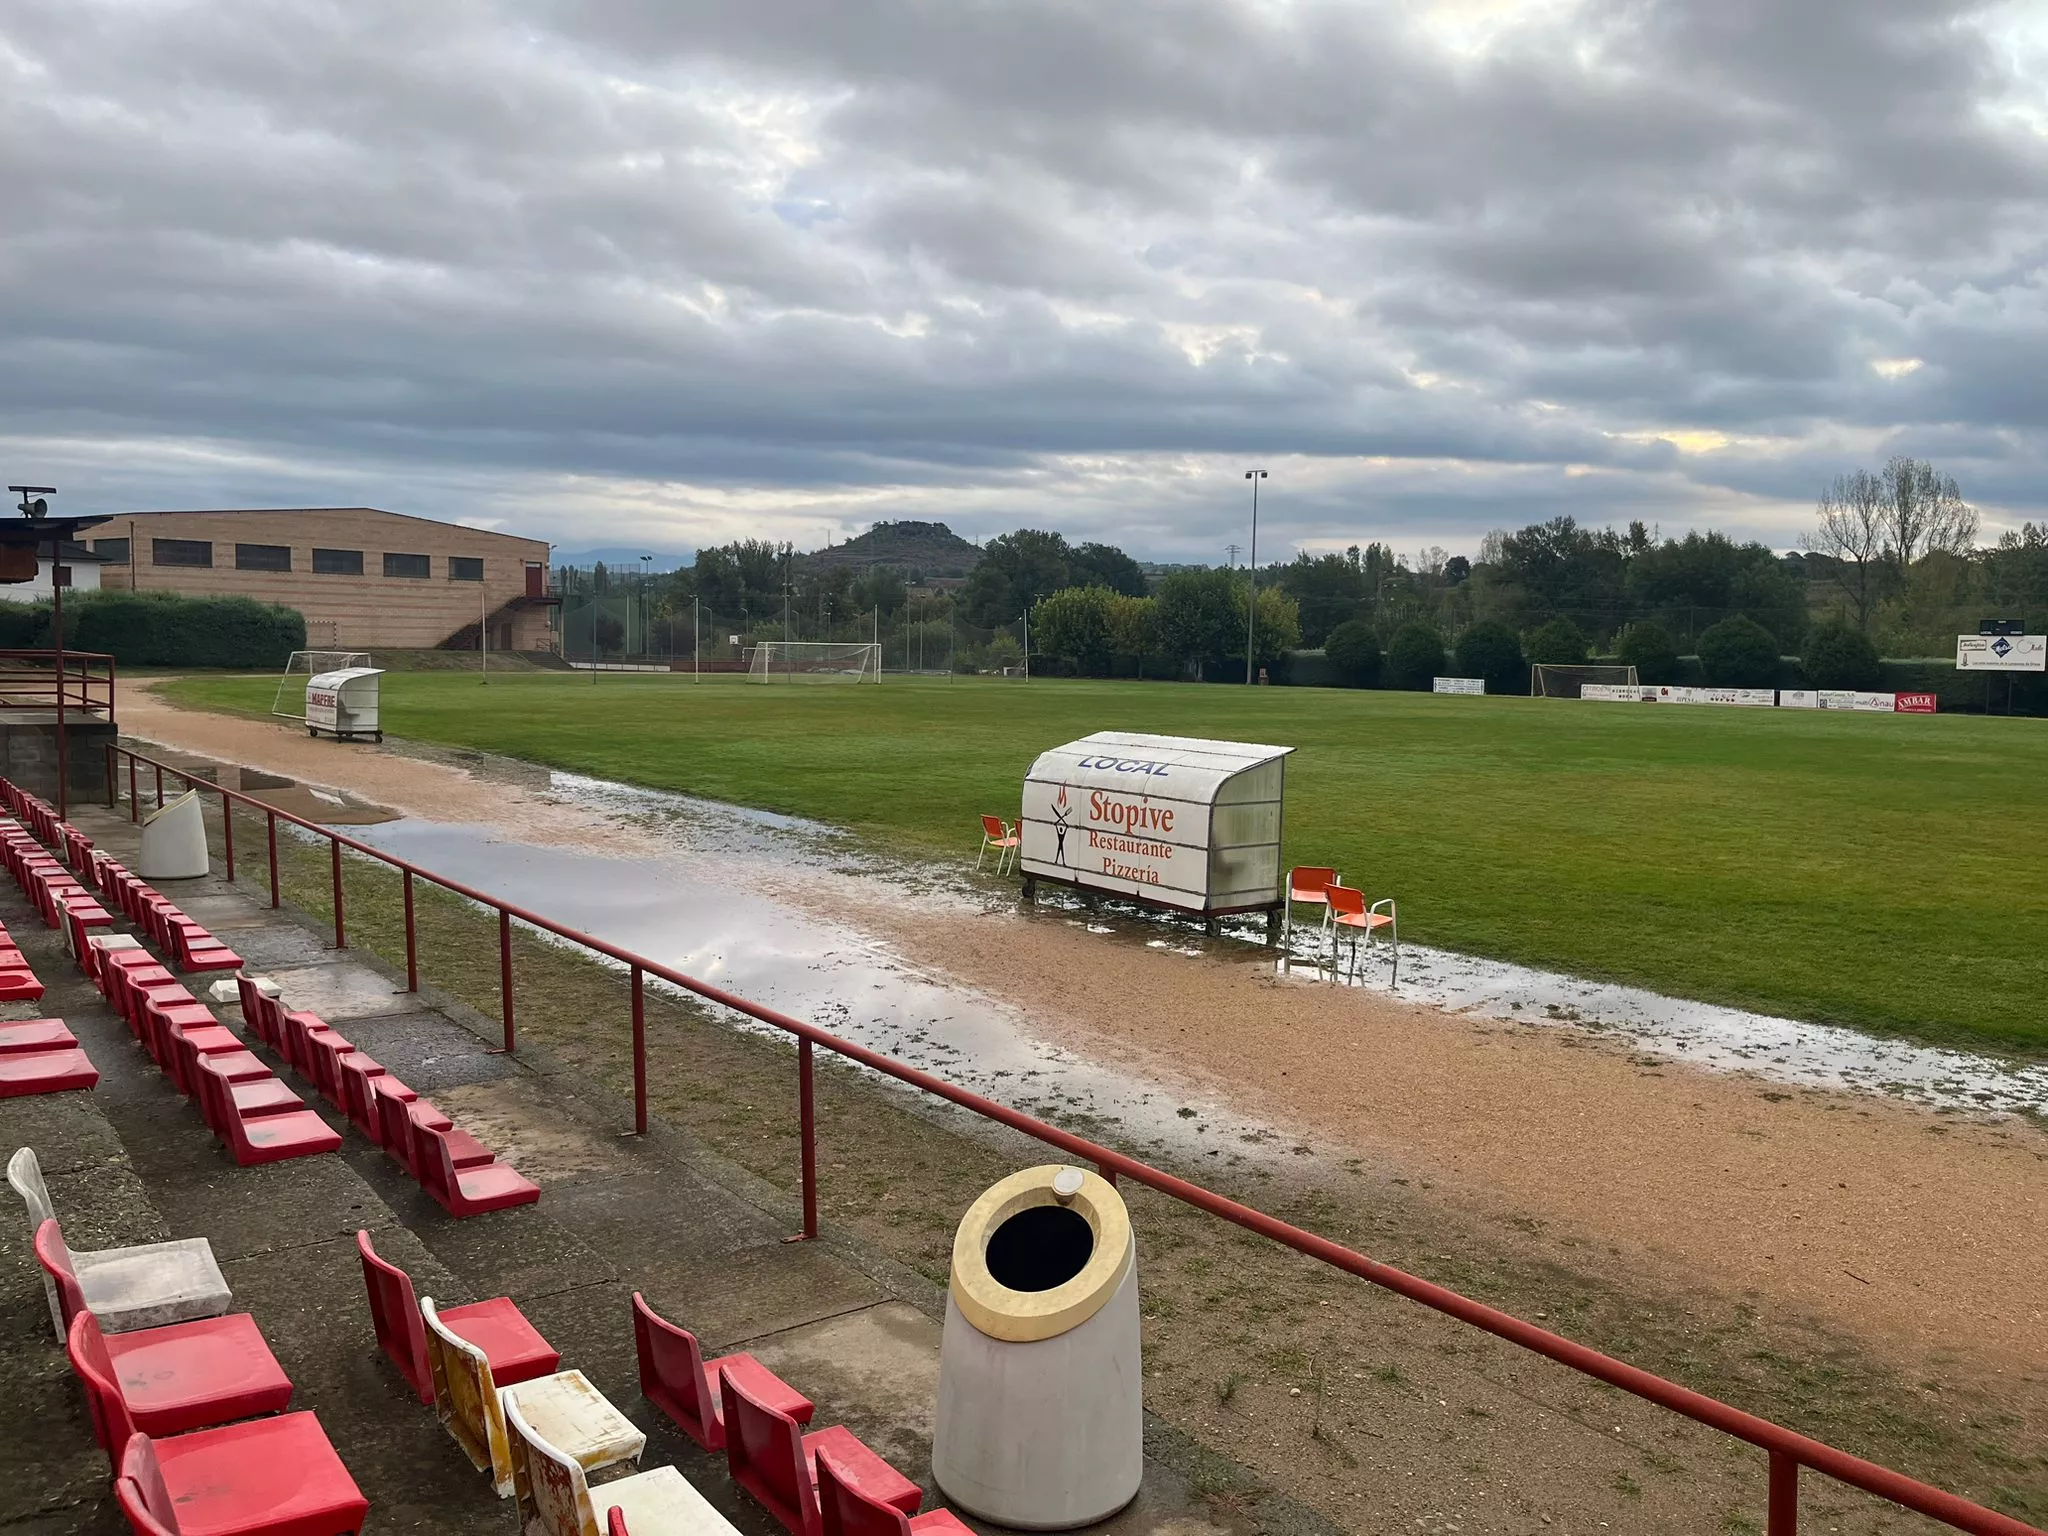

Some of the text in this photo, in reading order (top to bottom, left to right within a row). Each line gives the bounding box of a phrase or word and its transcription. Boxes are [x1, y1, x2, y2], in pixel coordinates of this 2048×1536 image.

[312, 692, 336, 706] MAPFRE
[1897, 695, 1931, 710] AMBAR
[1078, 755, 1169, 777] LOCAL
[1089, 789, 1174, 836] Stopive
[1088, 830, 1173, 859] Restaurante
[1102, 856, 1160, 884] Pizzería
